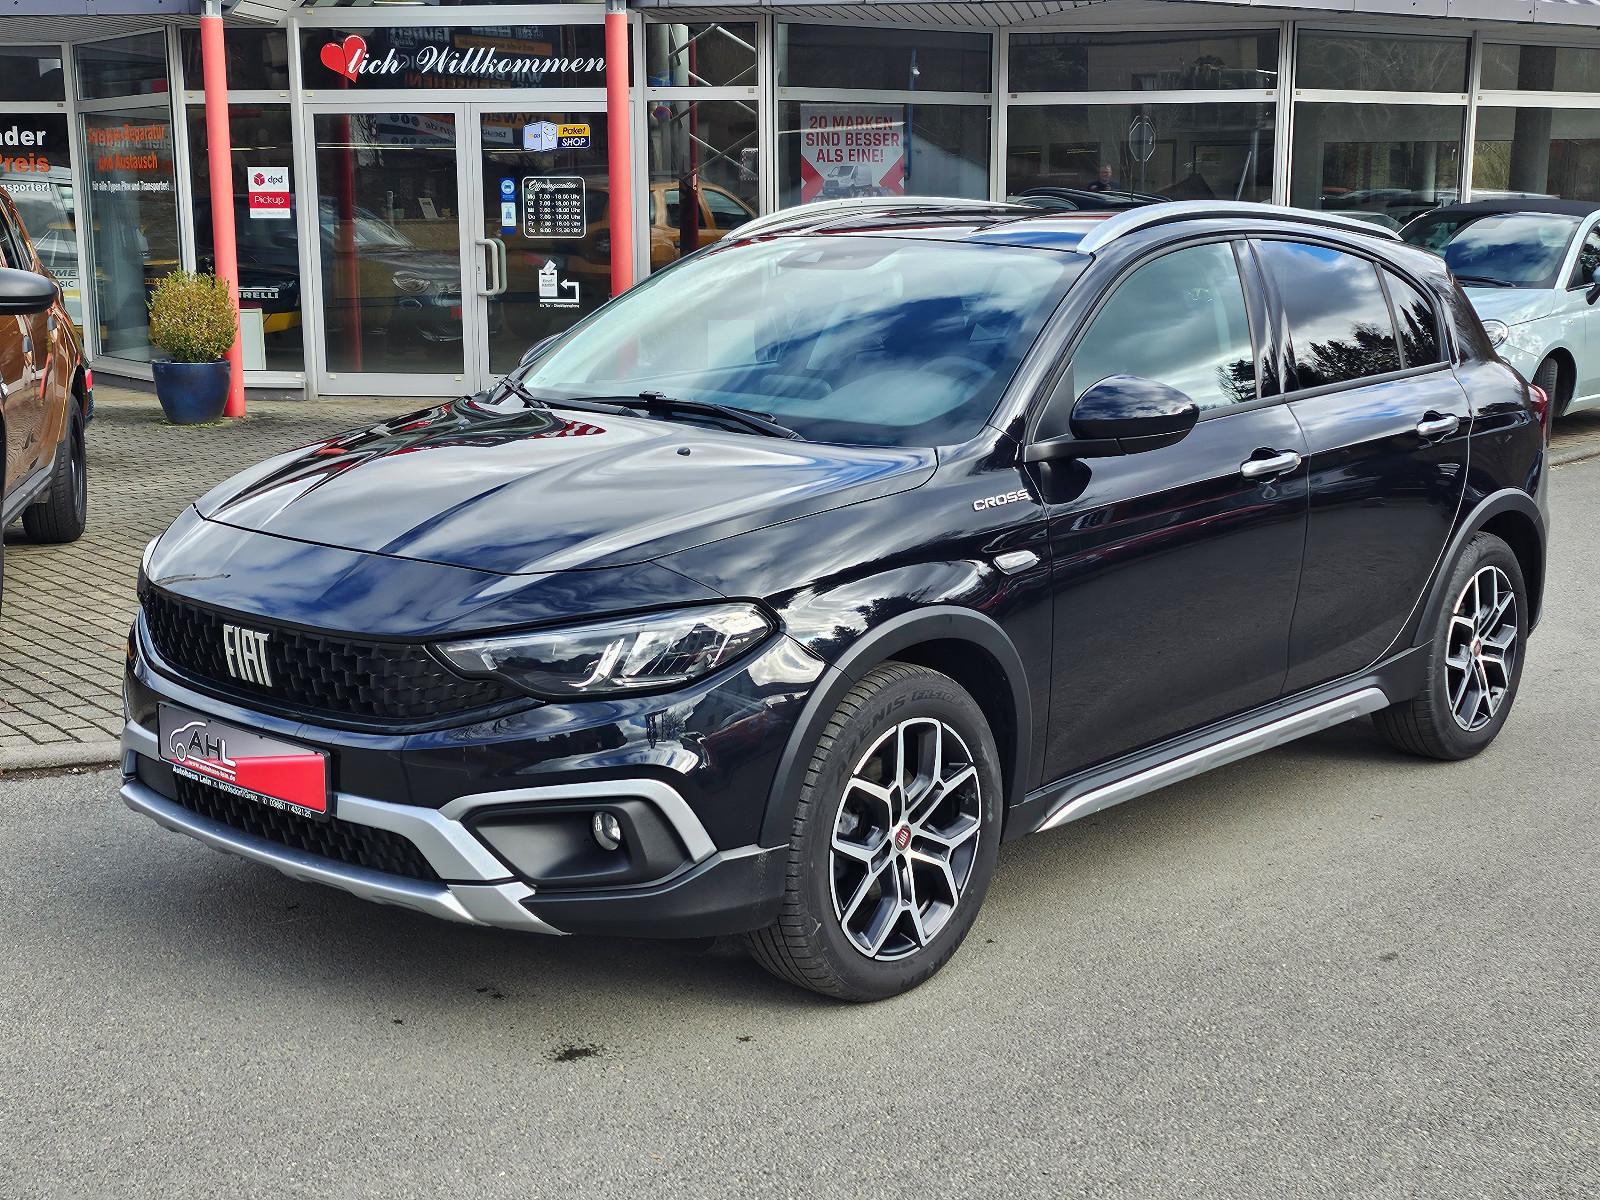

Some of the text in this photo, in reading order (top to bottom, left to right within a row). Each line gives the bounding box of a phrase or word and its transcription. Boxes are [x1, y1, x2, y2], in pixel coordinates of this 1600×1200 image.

[347, 46, 607, 74] lich Willkommen
[562, 126, 586, 135] Paket
[810, 116, 893, 130] 20 MARKEN
[0, 125, 47, 146] der
[561, 137, 587, 147] SHOP
[806, 132, 900, 147] SIND BESSER
[0, 152, 50, 173] reis
[816, 148, 884, 163] ALS EINE!
[267, 175, 283, 185] dpd
[254, 194, 285, 205] Pickup
[973, 488, 1031, 511] CROSS
[223, 623, 273, 688] FIAT
[188, 729, 236, 767] AHL
[172, 764, 199, 781] Autohaus
